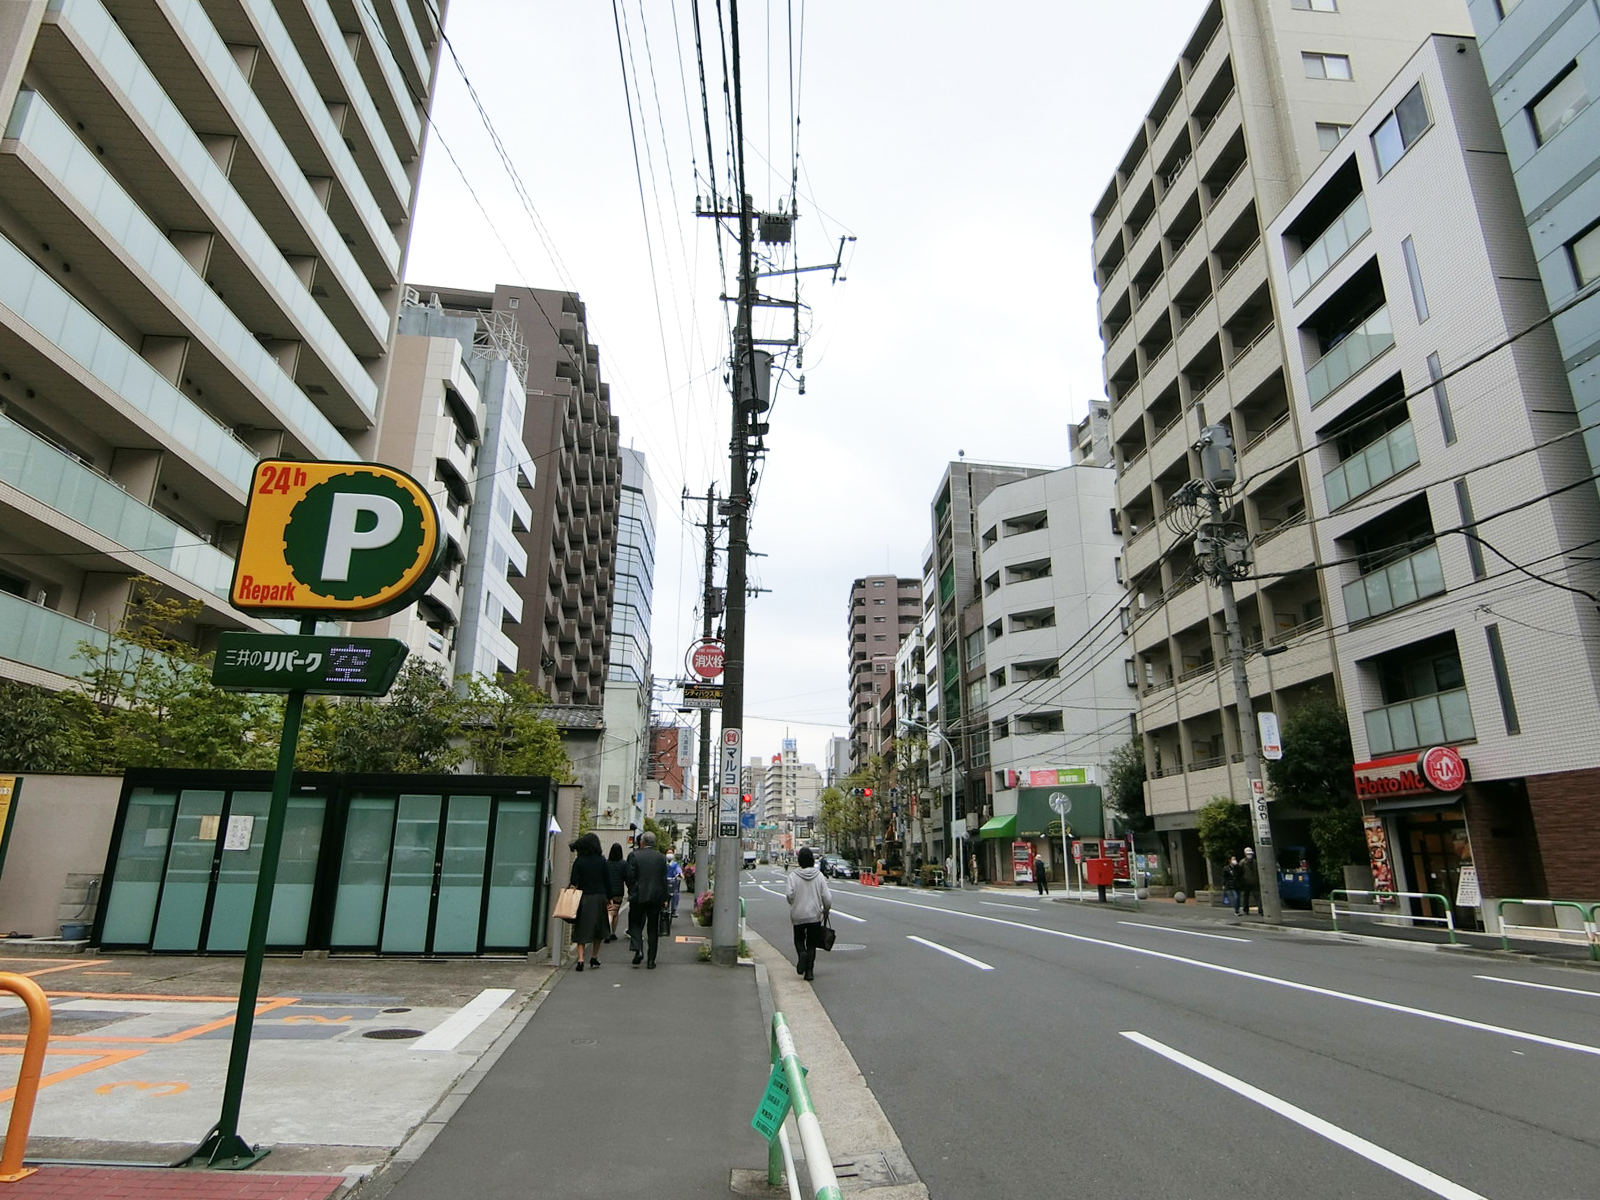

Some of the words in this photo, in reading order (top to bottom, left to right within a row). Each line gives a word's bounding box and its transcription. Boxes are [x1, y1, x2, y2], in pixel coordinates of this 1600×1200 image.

[258, 465, 307, 495] 24h
[320, 492, 404, 582] P
[238, 575, 296, 603] Repark
[224, 649, 322, 673] 三井のリパーク
[325, 644, 371, 682] 空
[695, 654, 725, 669] 消火栓
[725, 747, 738, 785] マルヨ
[1430, 761, 1461, 778] HM
[1356, 776, 1399, 795] Hotto
